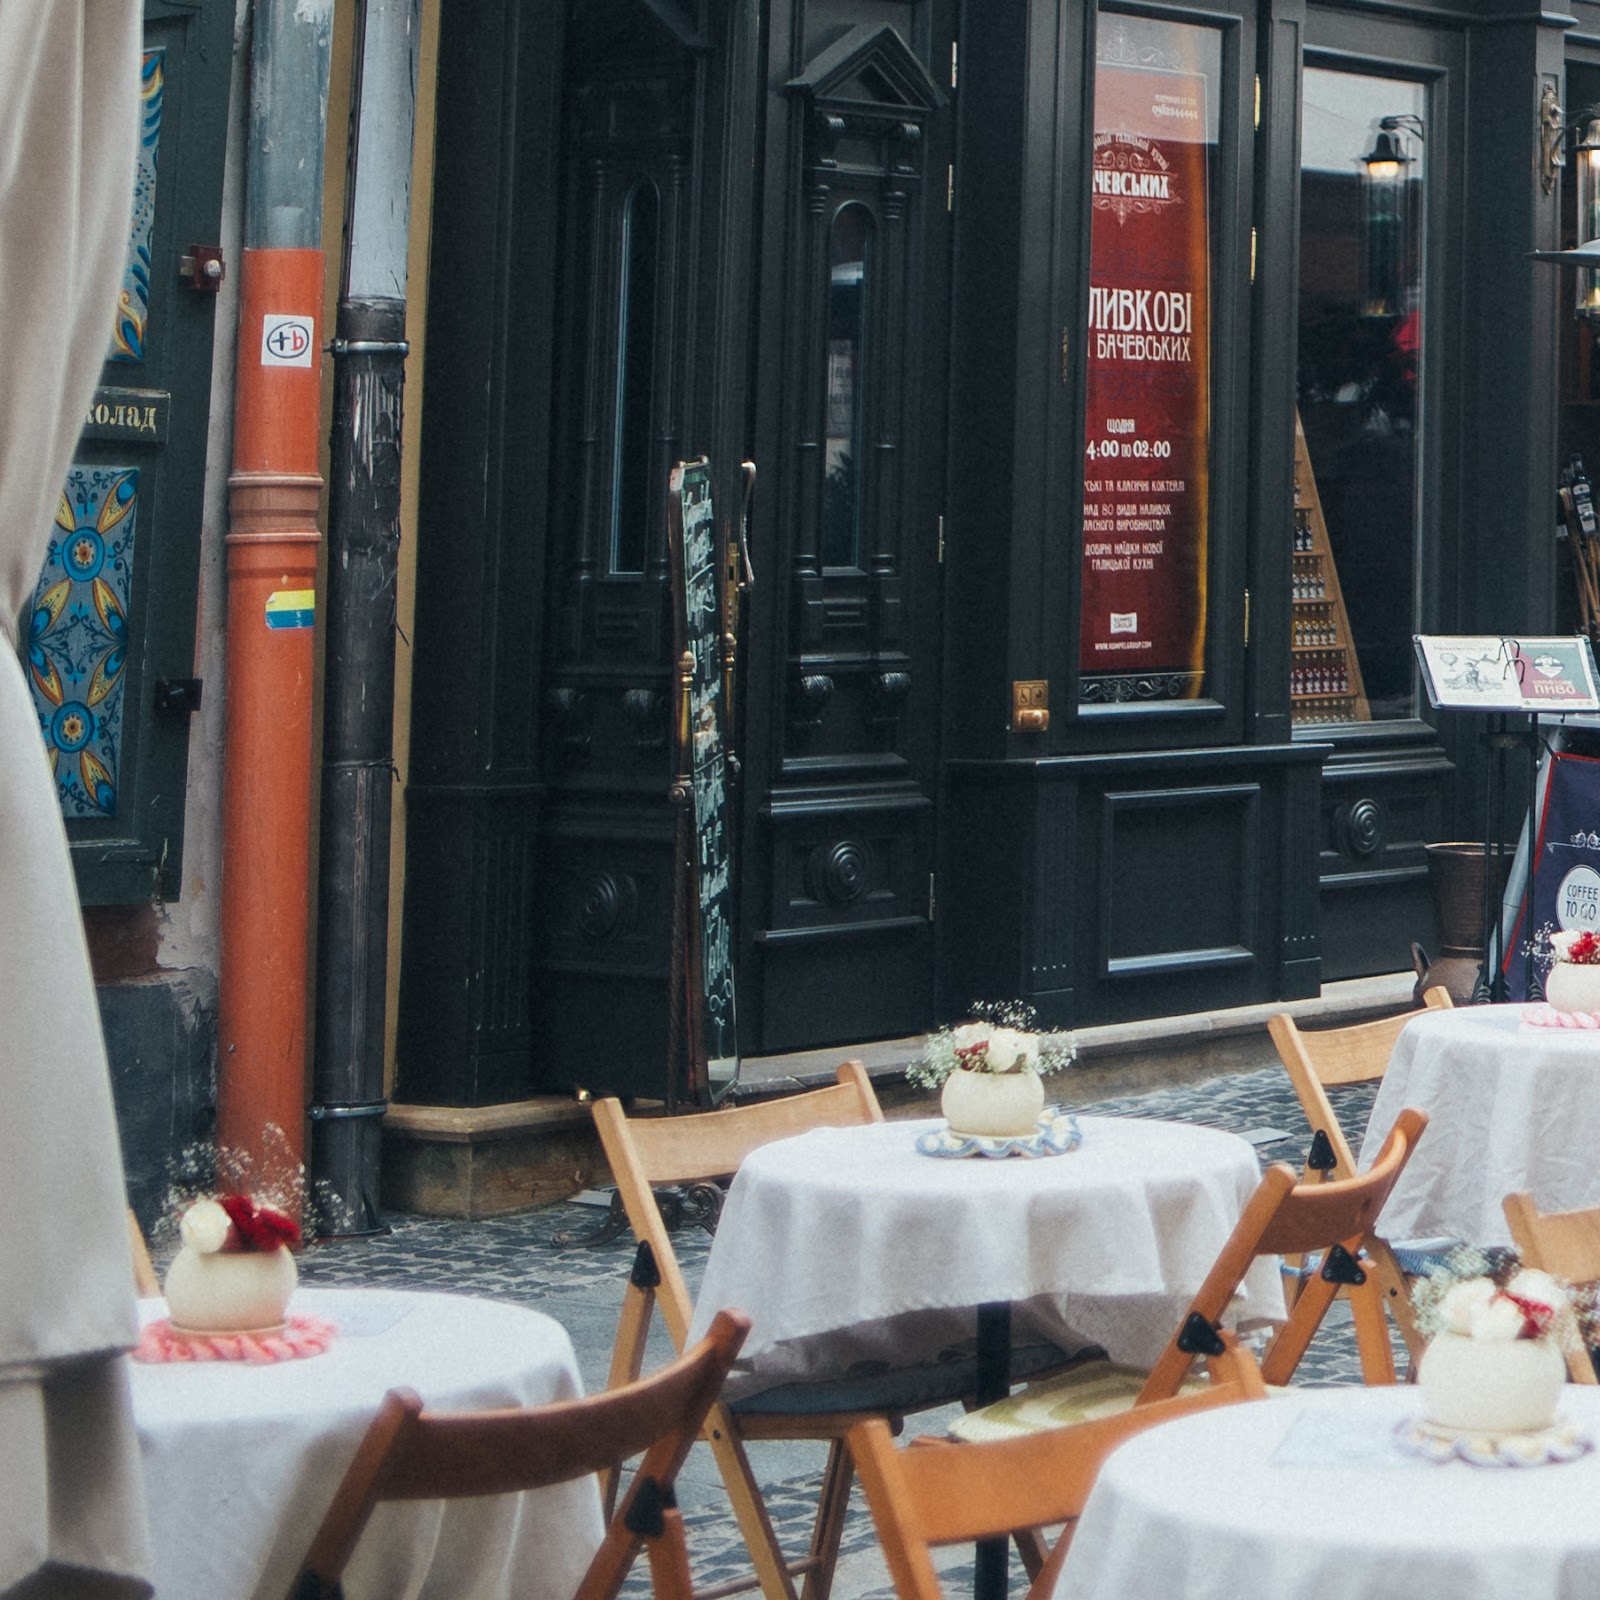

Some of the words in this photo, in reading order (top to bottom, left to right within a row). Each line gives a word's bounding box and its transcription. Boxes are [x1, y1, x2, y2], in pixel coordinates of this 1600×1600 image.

[1097, 333, 1191, 361] БАЧЕВСЬКИХ
[1133, 440, 1171, 458] 02:00
[1567, 884, 1599, 900] COFFEE
[1566, 901, 1577, 917] TO
[1580, 903, 1597, 920] GO
